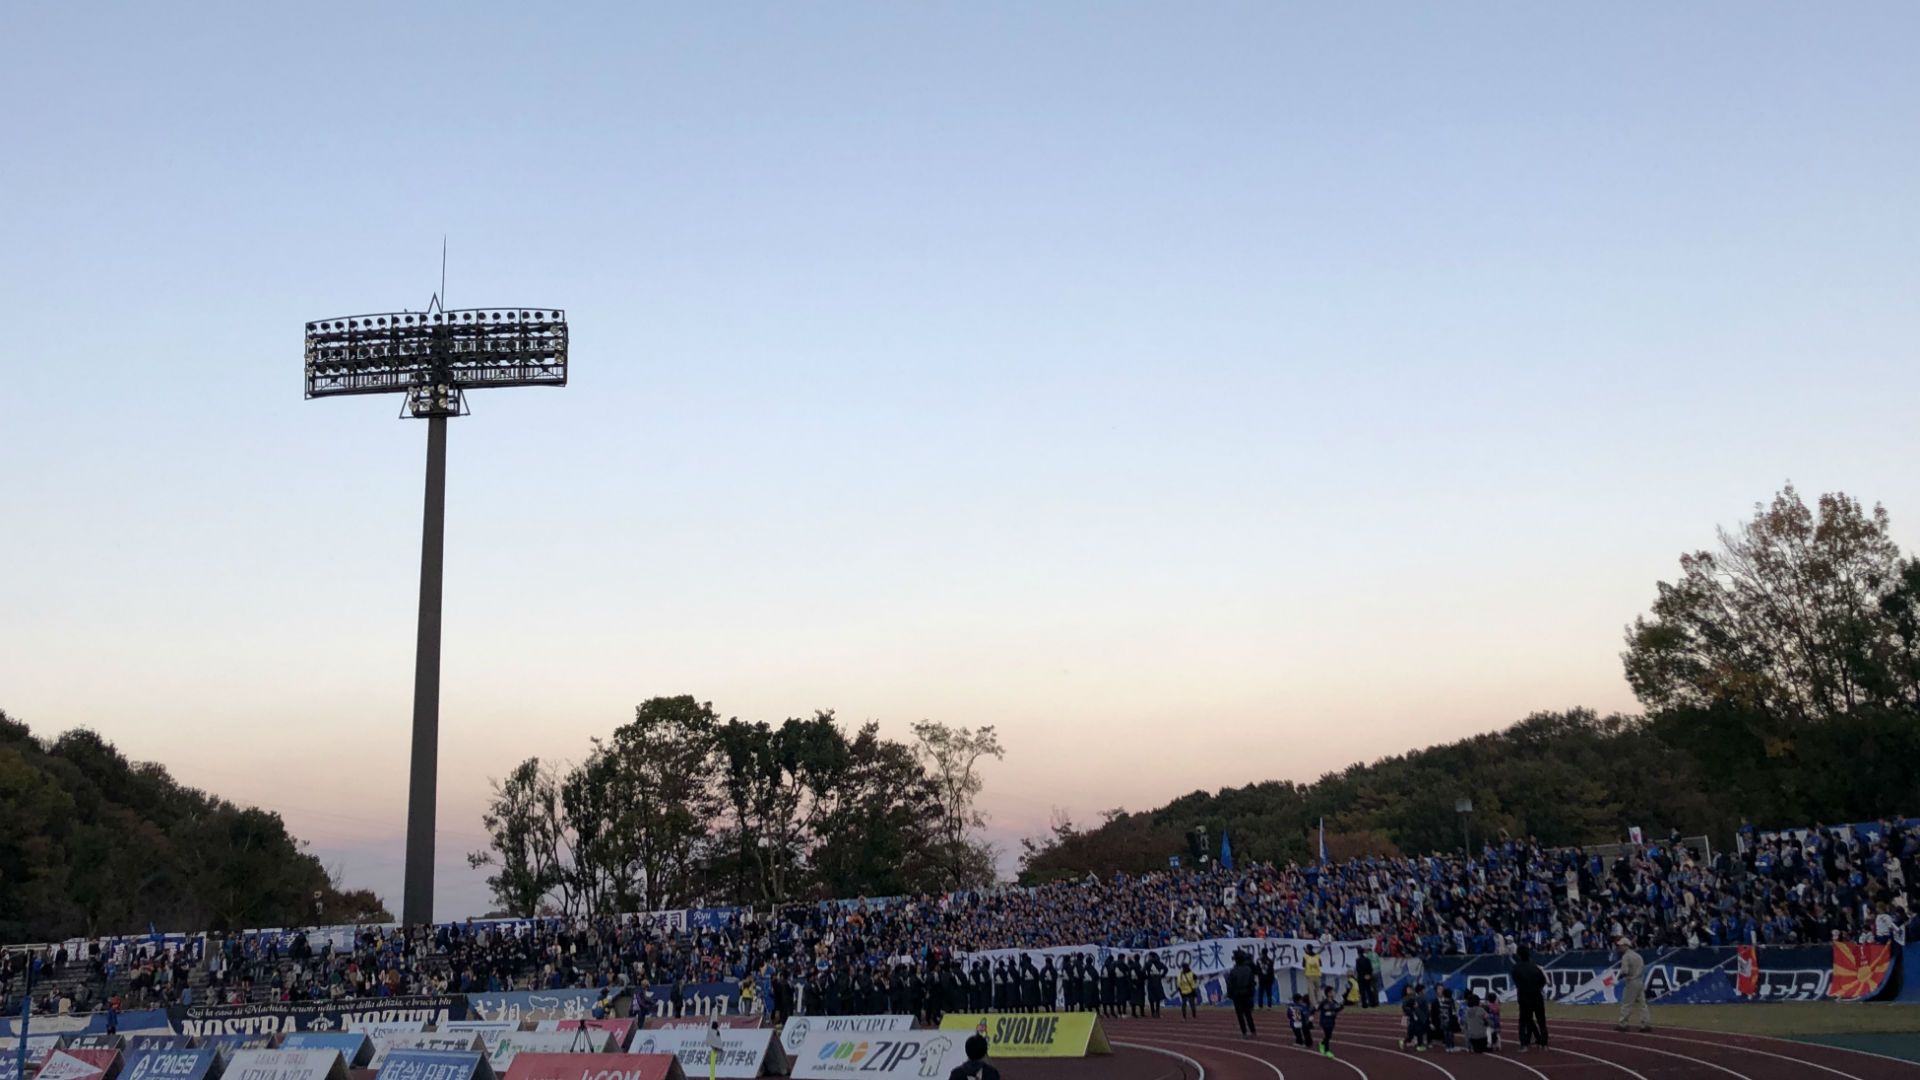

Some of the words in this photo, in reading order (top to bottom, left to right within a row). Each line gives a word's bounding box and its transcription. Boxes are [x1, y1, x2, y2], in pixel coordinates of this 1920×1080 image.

[187, 1007, 205, 1019] Qui
[205, 1008, 214, 1017] la
[234, 1007, 244, 1016] di
[318, 1002, 337, 1012] nella
[356, 999, 375, 1010] della
[438, 997, 452, 1006] blu
[181, 1014, 297, 1037] NOSTRA
[993, 1016, 1059, 1044] SVOLME
[860, 1040, 921, 1072] ZIP
